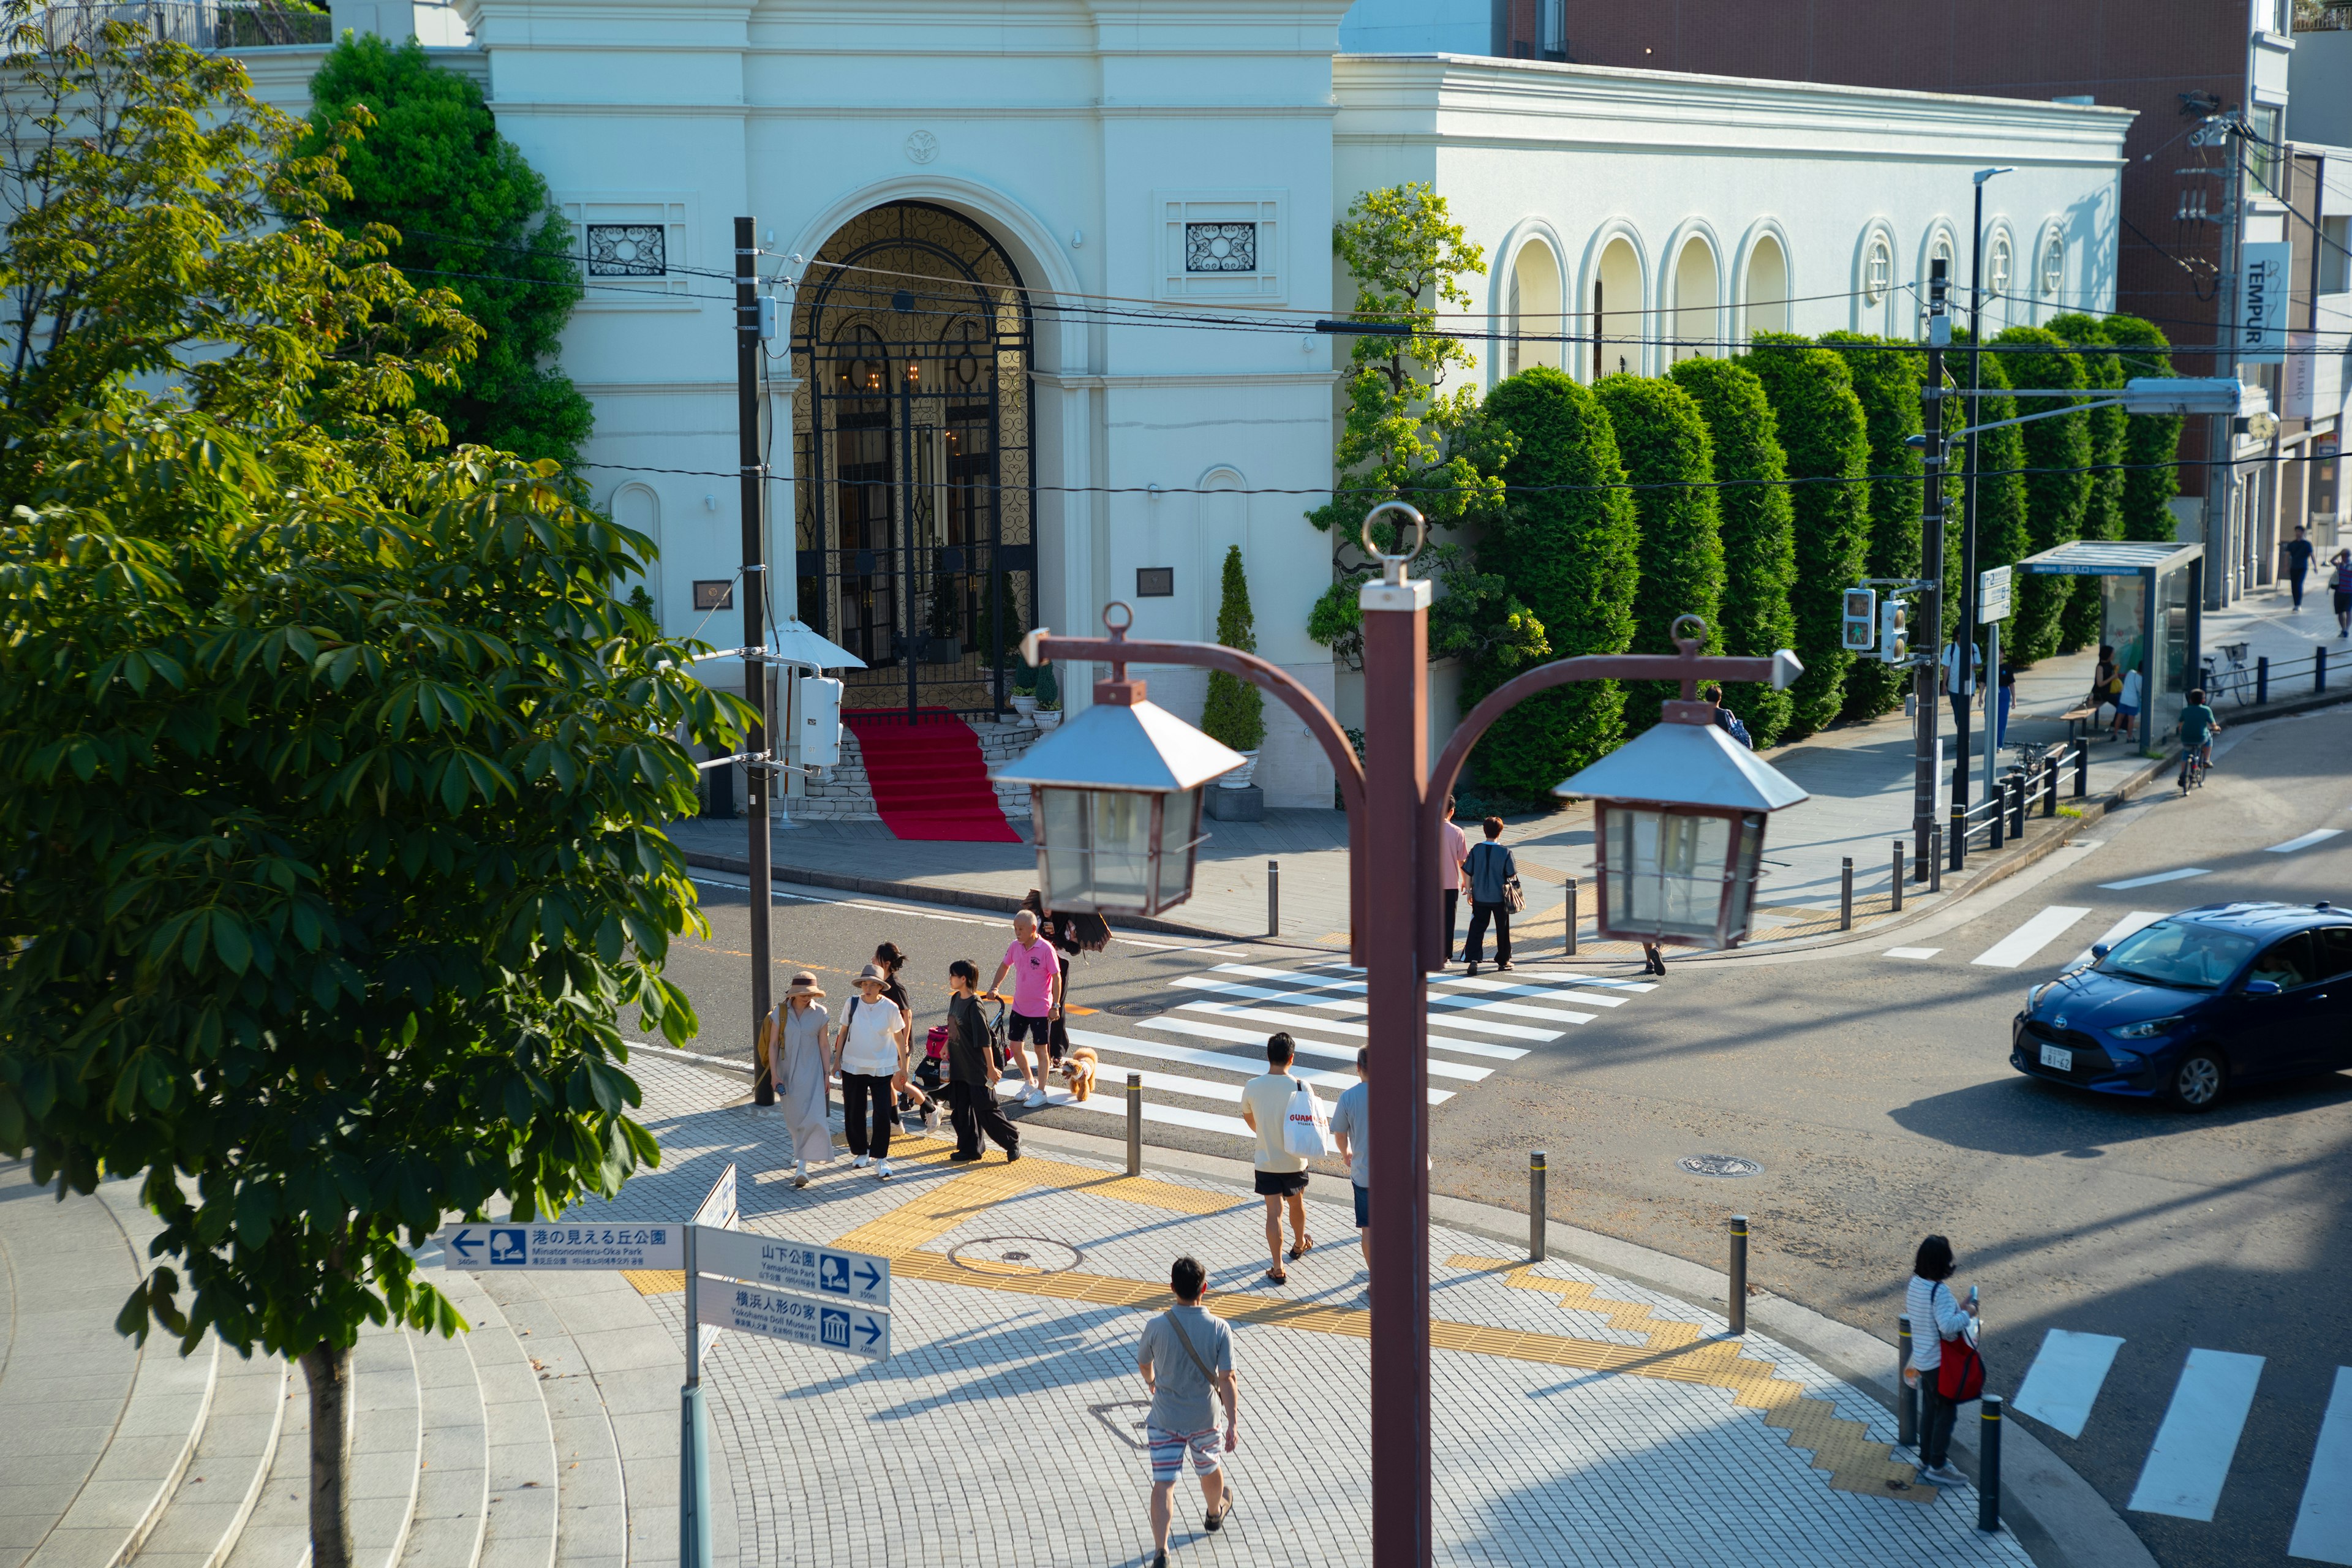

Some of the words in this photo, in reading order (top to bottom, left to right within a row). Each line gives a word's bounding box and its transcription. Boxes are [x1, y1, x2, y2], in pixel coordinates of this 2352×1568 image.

[2245, 260, 2266, 344] TEMPUR
[2296, 352, 2306, 401] -PRIMO
[532, 1229, 666, 1245] 港の見える丘公園
[532, 1247, 620, 1256] Minatonomieru-Oka
[623, 1247, 643, 1256] Park
[762, 1244, 815, 1267] 山下公園
[761, 1261, 799, 1275] Yamashita
[800, 1268, 816, 1279] Park
[735, 1290, 816, 1321] 横浜人形の家
[859, 1291, 877, 1301] 350m
[731, 1307, 768, 1322] Yokohama
[770, 1316, 785, 1325] Doll
[786, 1319, 816, 1333] Museum
[859, 1344, 877, 1355] 220m
